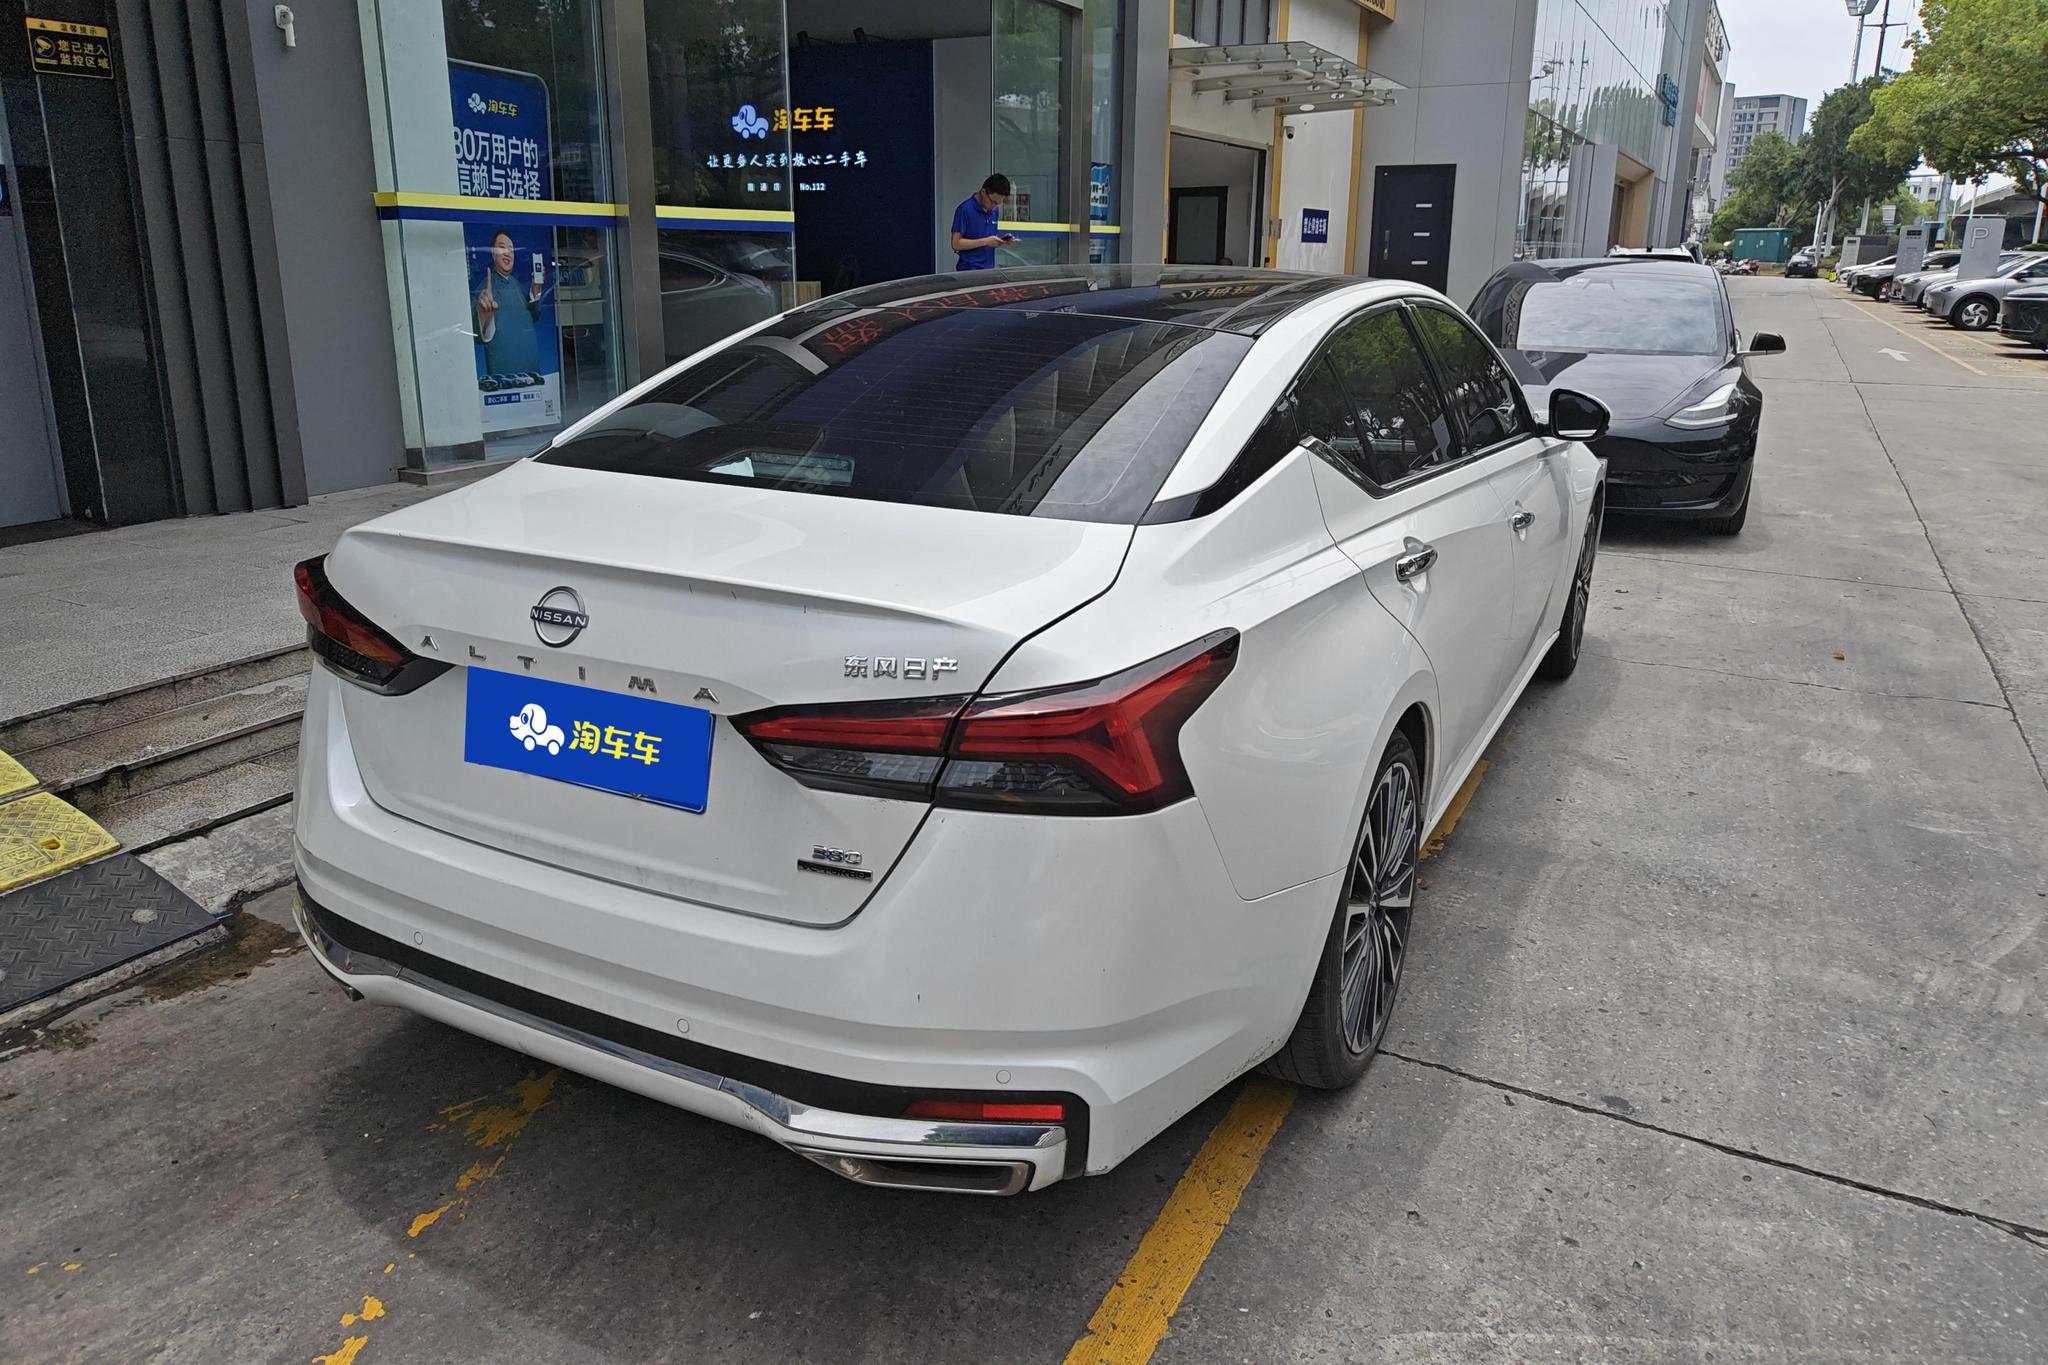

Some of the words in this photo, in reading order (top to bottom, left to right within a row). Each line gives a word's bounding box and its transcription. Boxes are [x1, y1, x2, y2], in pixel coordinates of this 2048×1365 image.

[57, 40, 108, 57] 您已进入
[60, 53, 110, 69] 监控区域
[487, 99, 519, 118] 淘车车
[771, 106, 835, 132] 淘车车
[706, 150, 869, 168] 让更多人买到放心二手车
[799, 182, 826, 192] No.112
[1970, 227, 1990, 249] P
[531, 608, 587, 627] NISSAN
[420, 635, 720, 704] ALTIMA
[843, 655, 959, 681] 东风日产
